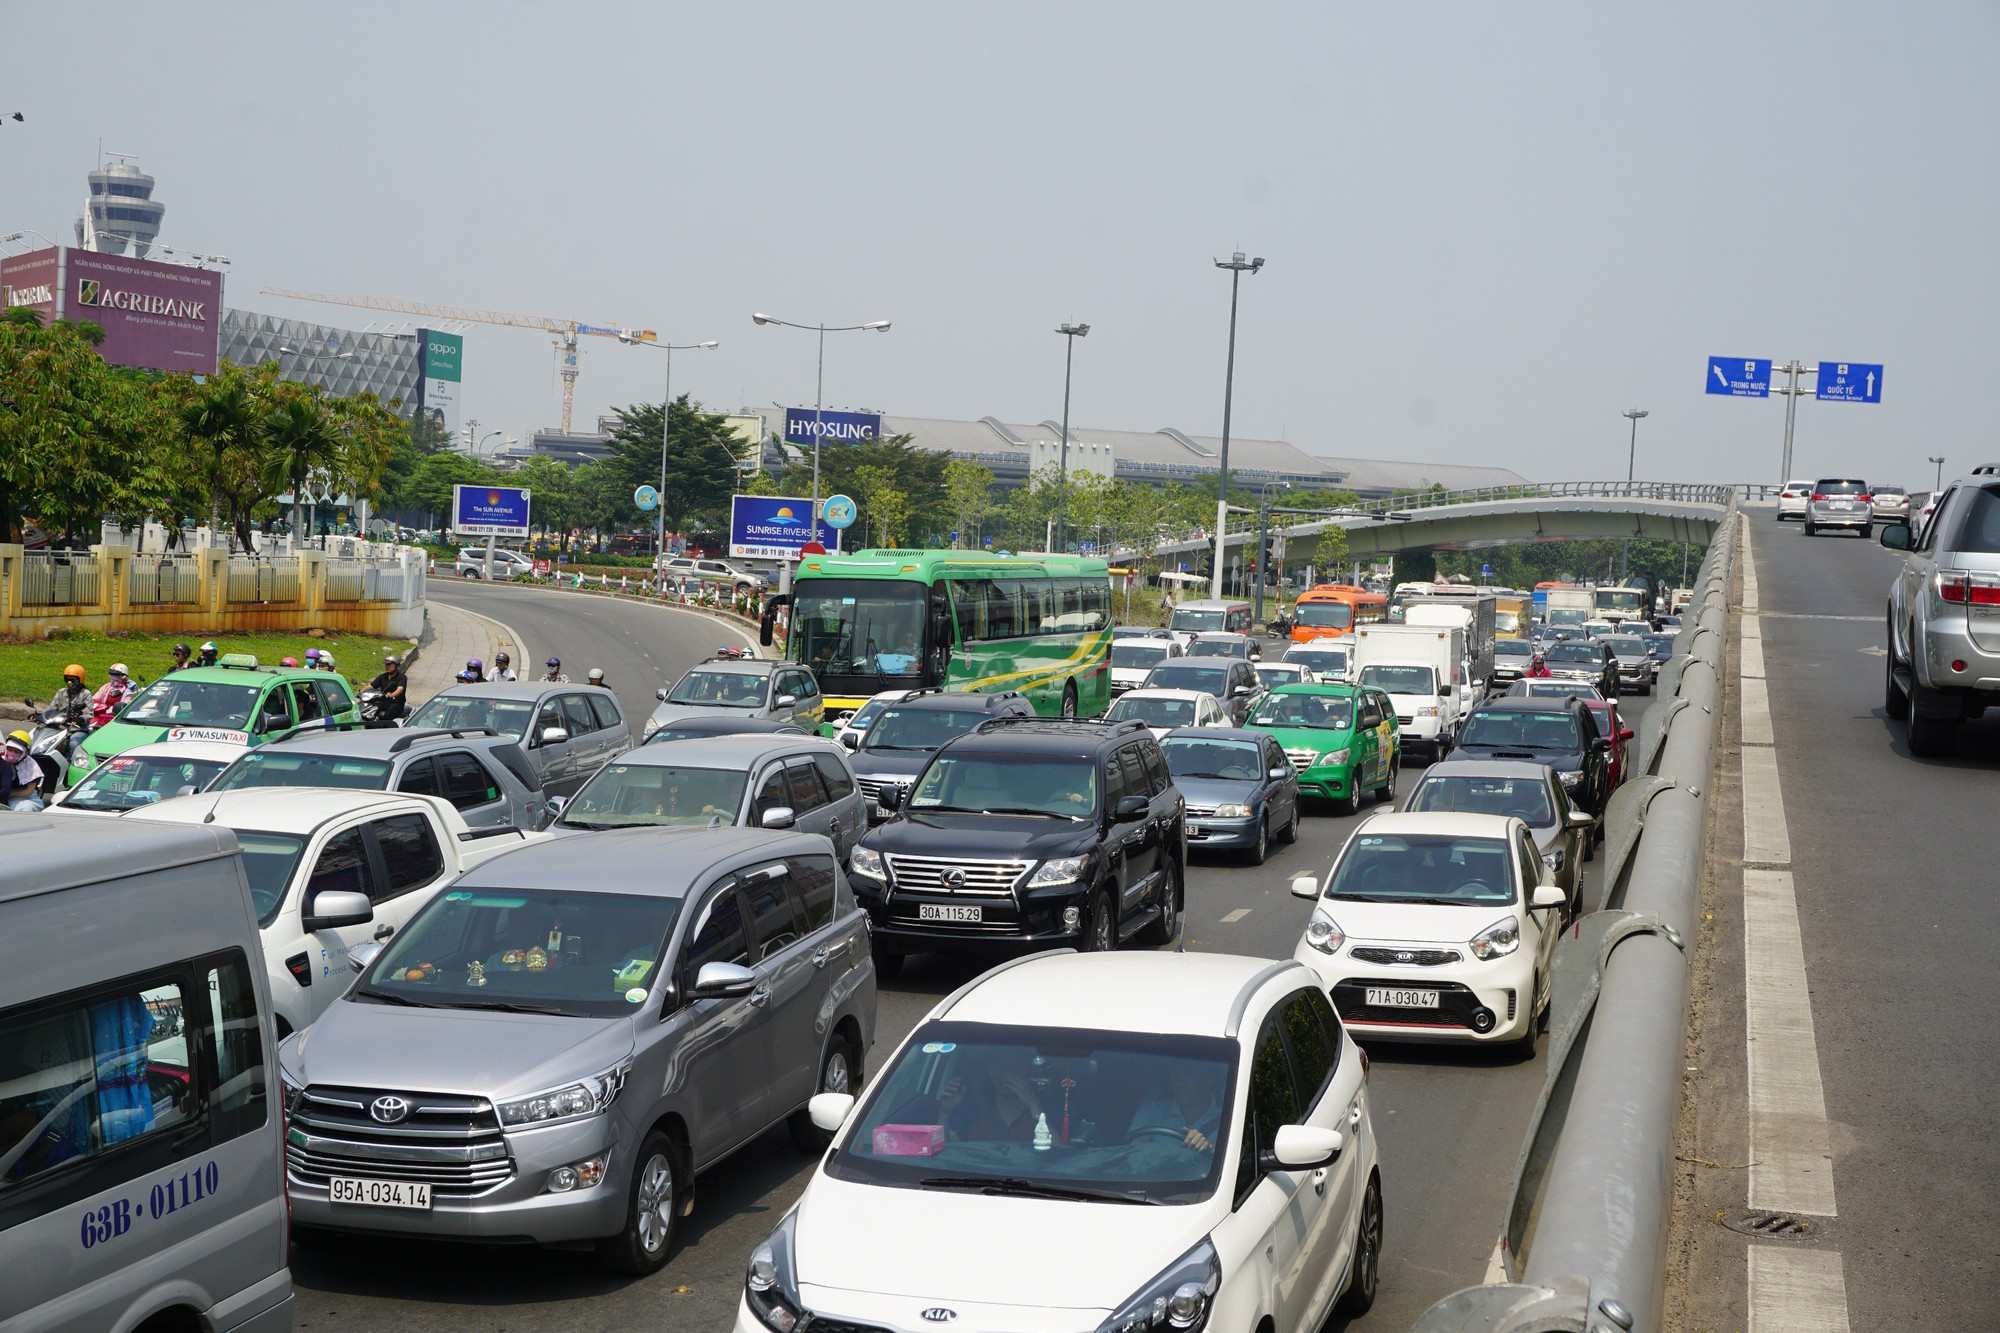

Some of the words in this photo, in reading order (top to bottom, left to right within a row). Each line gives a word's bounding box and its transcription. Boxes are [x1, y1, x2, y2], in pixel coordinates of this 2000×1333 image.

[201, 278, 211, 286] NAM
[100, 289, 205, 320] AGRIBANK
[126, 314, 140, 324] Mang
[1731, 381, 1749, 389] TRONG
[1827, 385, 1844, 394] QUỐC
[1845, 385, 1855, 394] TẾ
[790, 420, 872, 440] HYOSUNG
[746, 525, 782, 535] SUNRISE
[783, 528, 824, 538] RIVERSDE
[921, 906, 980, 920] 30A-115.29
[323, 965, 347, 978] Process
[1368, 990, 1436, 1006] 71A-030.47
[332, 1179, 428, 1207] 95A-034.14
[925, 1309, 952, 1320] KIA
